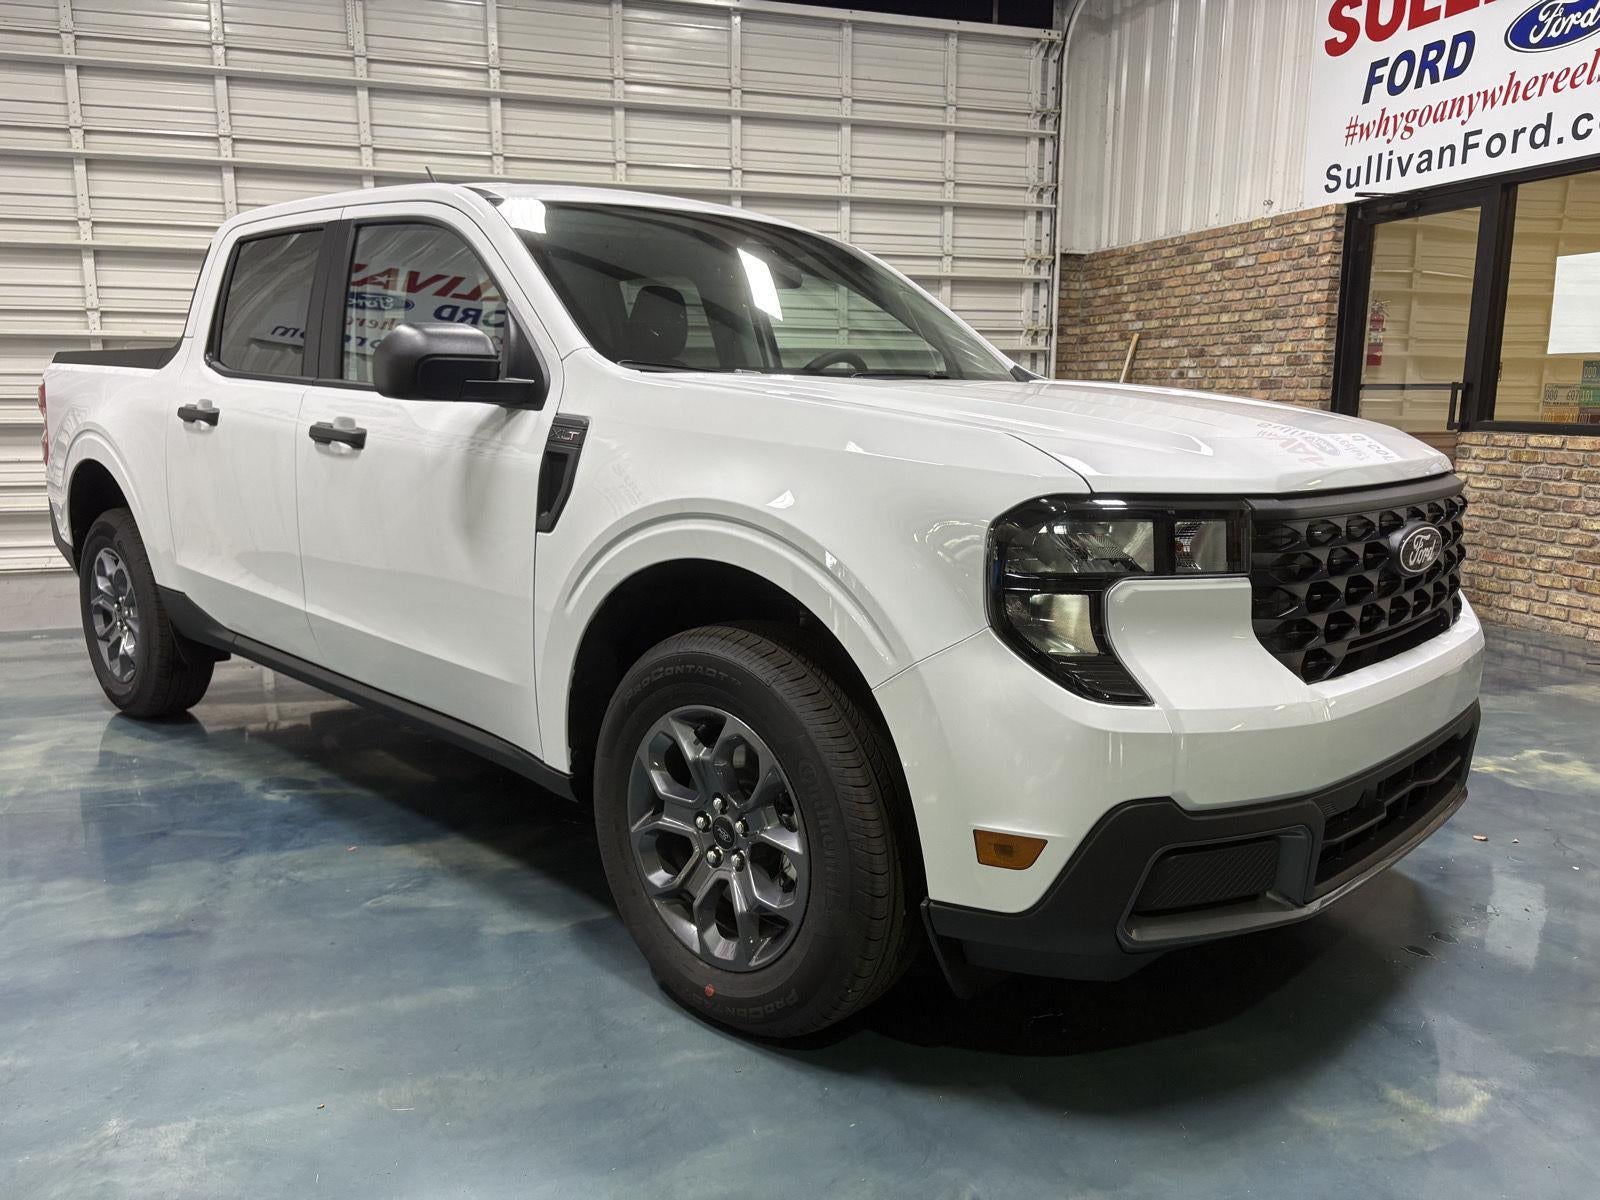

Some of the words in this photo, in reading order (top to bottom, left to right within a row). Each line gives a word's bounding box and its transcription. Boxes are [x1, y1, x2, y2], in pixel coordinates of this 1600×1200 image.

[1324, 0, 1497, 57] SUL
[1529, 0, 1600, 44] Ford
[1361, 30, 1476, 105] FORD
[1344, 48, 1600, 146] #whygoanywhereel
[1324, 112, 1600, 194] SullivanFord.c
[549, 428, 580, 441] XLT
[1408, 533, 1437, 566] Ford
